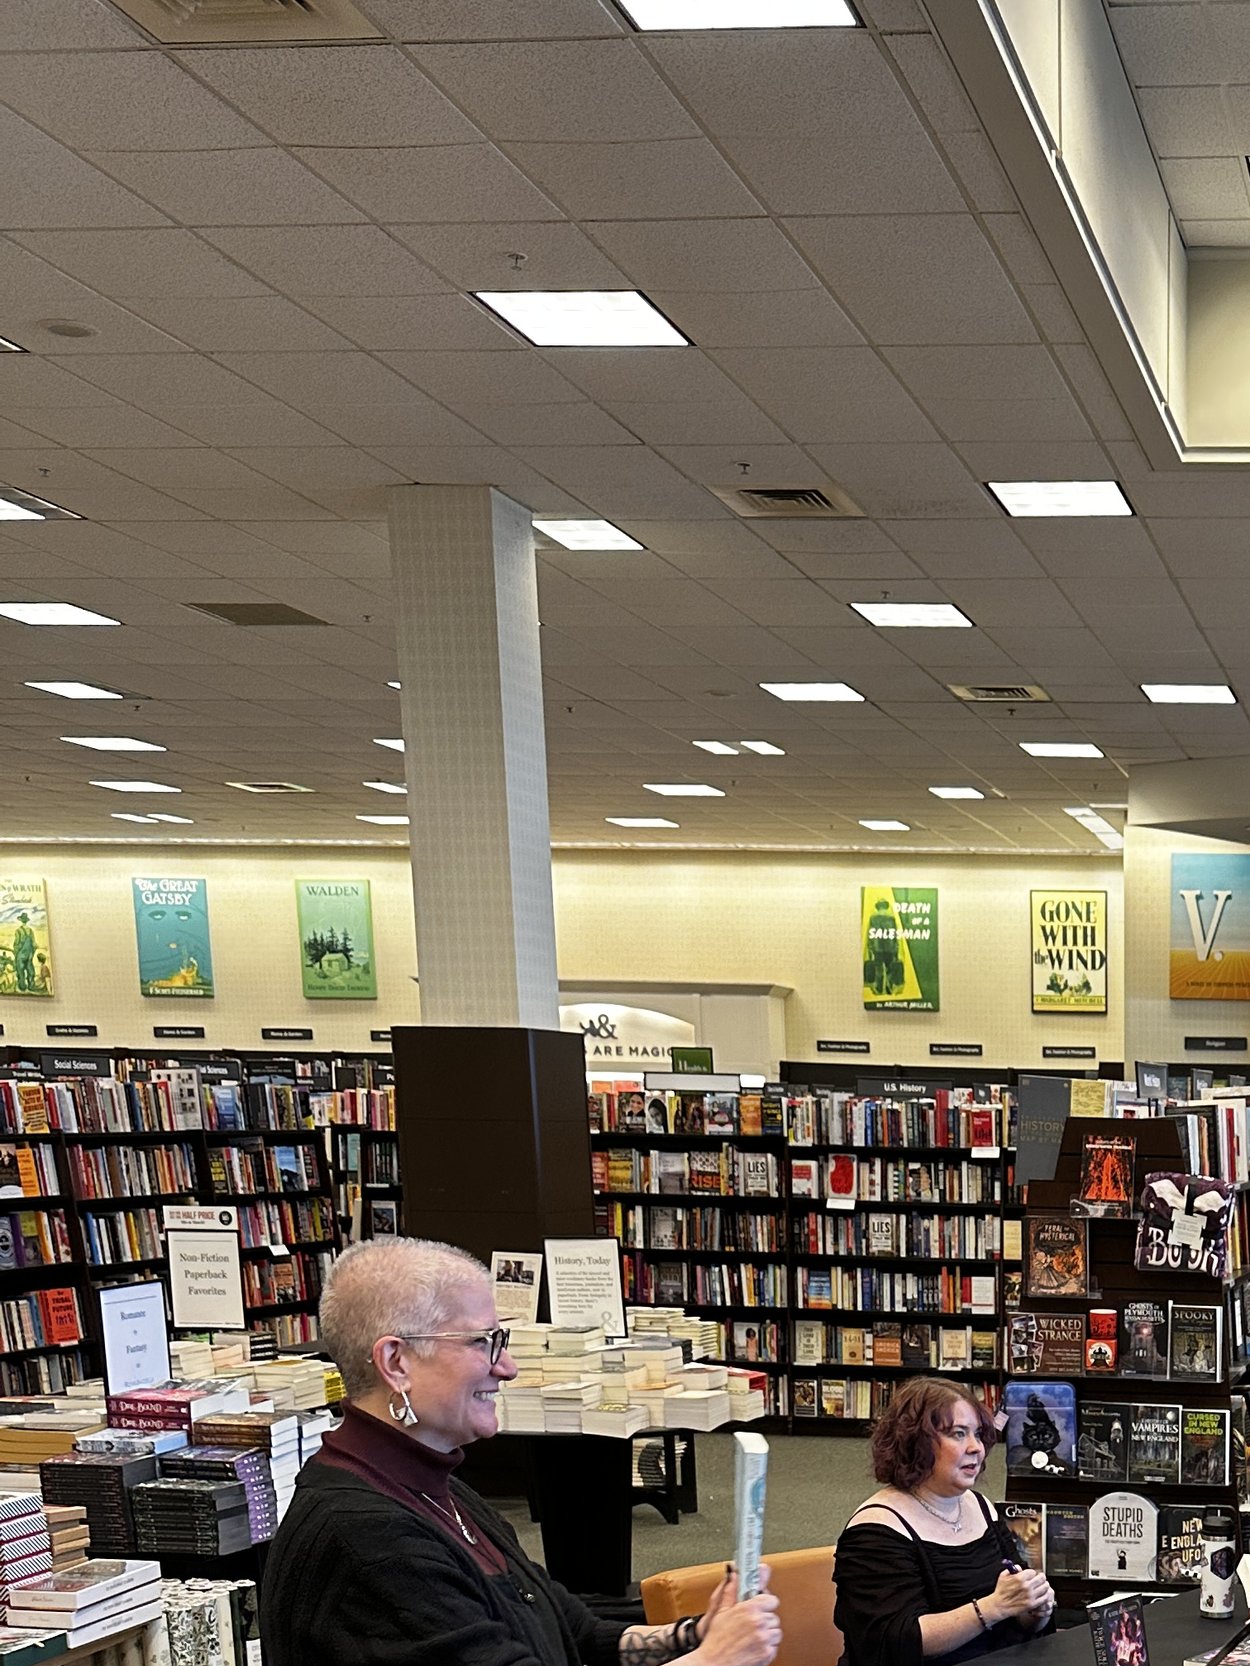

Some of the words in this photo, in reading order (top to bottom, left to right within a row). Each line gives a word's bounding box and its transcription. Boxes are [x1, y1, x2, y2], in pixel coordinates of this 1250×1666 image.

[135, 878, 157, 892] The
[160, 879, 199, 892] GREAT
[306, 886, 359, 896] WALDEN
[142, 892, 192, 905] GATSBY
[893, 902, 931, 914] DEATH
[1040, 900, 1097, 924] GONE
[868, 928, 931, 940] SALESMAN
[1040, 924, 1096, 947] WITH
[1047, 948, 1106, 972] WIND
[593, 1046, 624, 1056] ARE
[54, 1059, 72, 1070] Social
[72, 1060, 98, 1071] Sciences
[884, 1083, 898, 1092] U.S.
[899, 1084, 926, 1094] History
[1020, 1120, 1066, 1132] HISTORY
[748, 1162, 766, 1173] LIES
[182, 1210, 196, 1220] HALF
[198, 1210, 216, 1220] PRICE
[872, 1221, 890, 1233] LIES
[1039, 1232, 1075, 1241] HYSTERICAL
[180, 1252, 230, 1262] Non-Fiction
[554, 1256, 584, 1266] History,
[587, 1256, 612, 1266] Today
[184, 1269, 228, 1281] Paperback
[188, 1286, 226, 1296] Favorites
[1128, 1302, 1153, 1310] GHOSTS
[120, 1310, 146, 1320] Romance
[1124, 1309, 1163, 1318] PLYMOUTH
[1174, 1310, 1214, 1322] SPOOKY
[602, 1311, 618, 1334] &
[1038, 1318, 1082, 1330] WICKED
[1038, 1330, 1082, 1342] STRANGE
[138, 1402, 162, 1413] BOUND
[1187, 1413, 1220, 1421] CURSED
[138, 1418, 164, 1429] BOUND
[1131, 1422, 1178, 1433] VAMPIRES
[1184, 1426, 1224, 1436] ENGLAND
[1148, 1435, 1178, 1443] ENGLAND
[1005, 1505, 1038, 1518] Ghosts
[1103, 1506, 1143, 1523] STUPID
[1102, 1522, 1144, 1539] DEATHS
[1182, 1520, 1202, 1534] NEW
[1171, 1534, 1202, 1550] ENGLA
